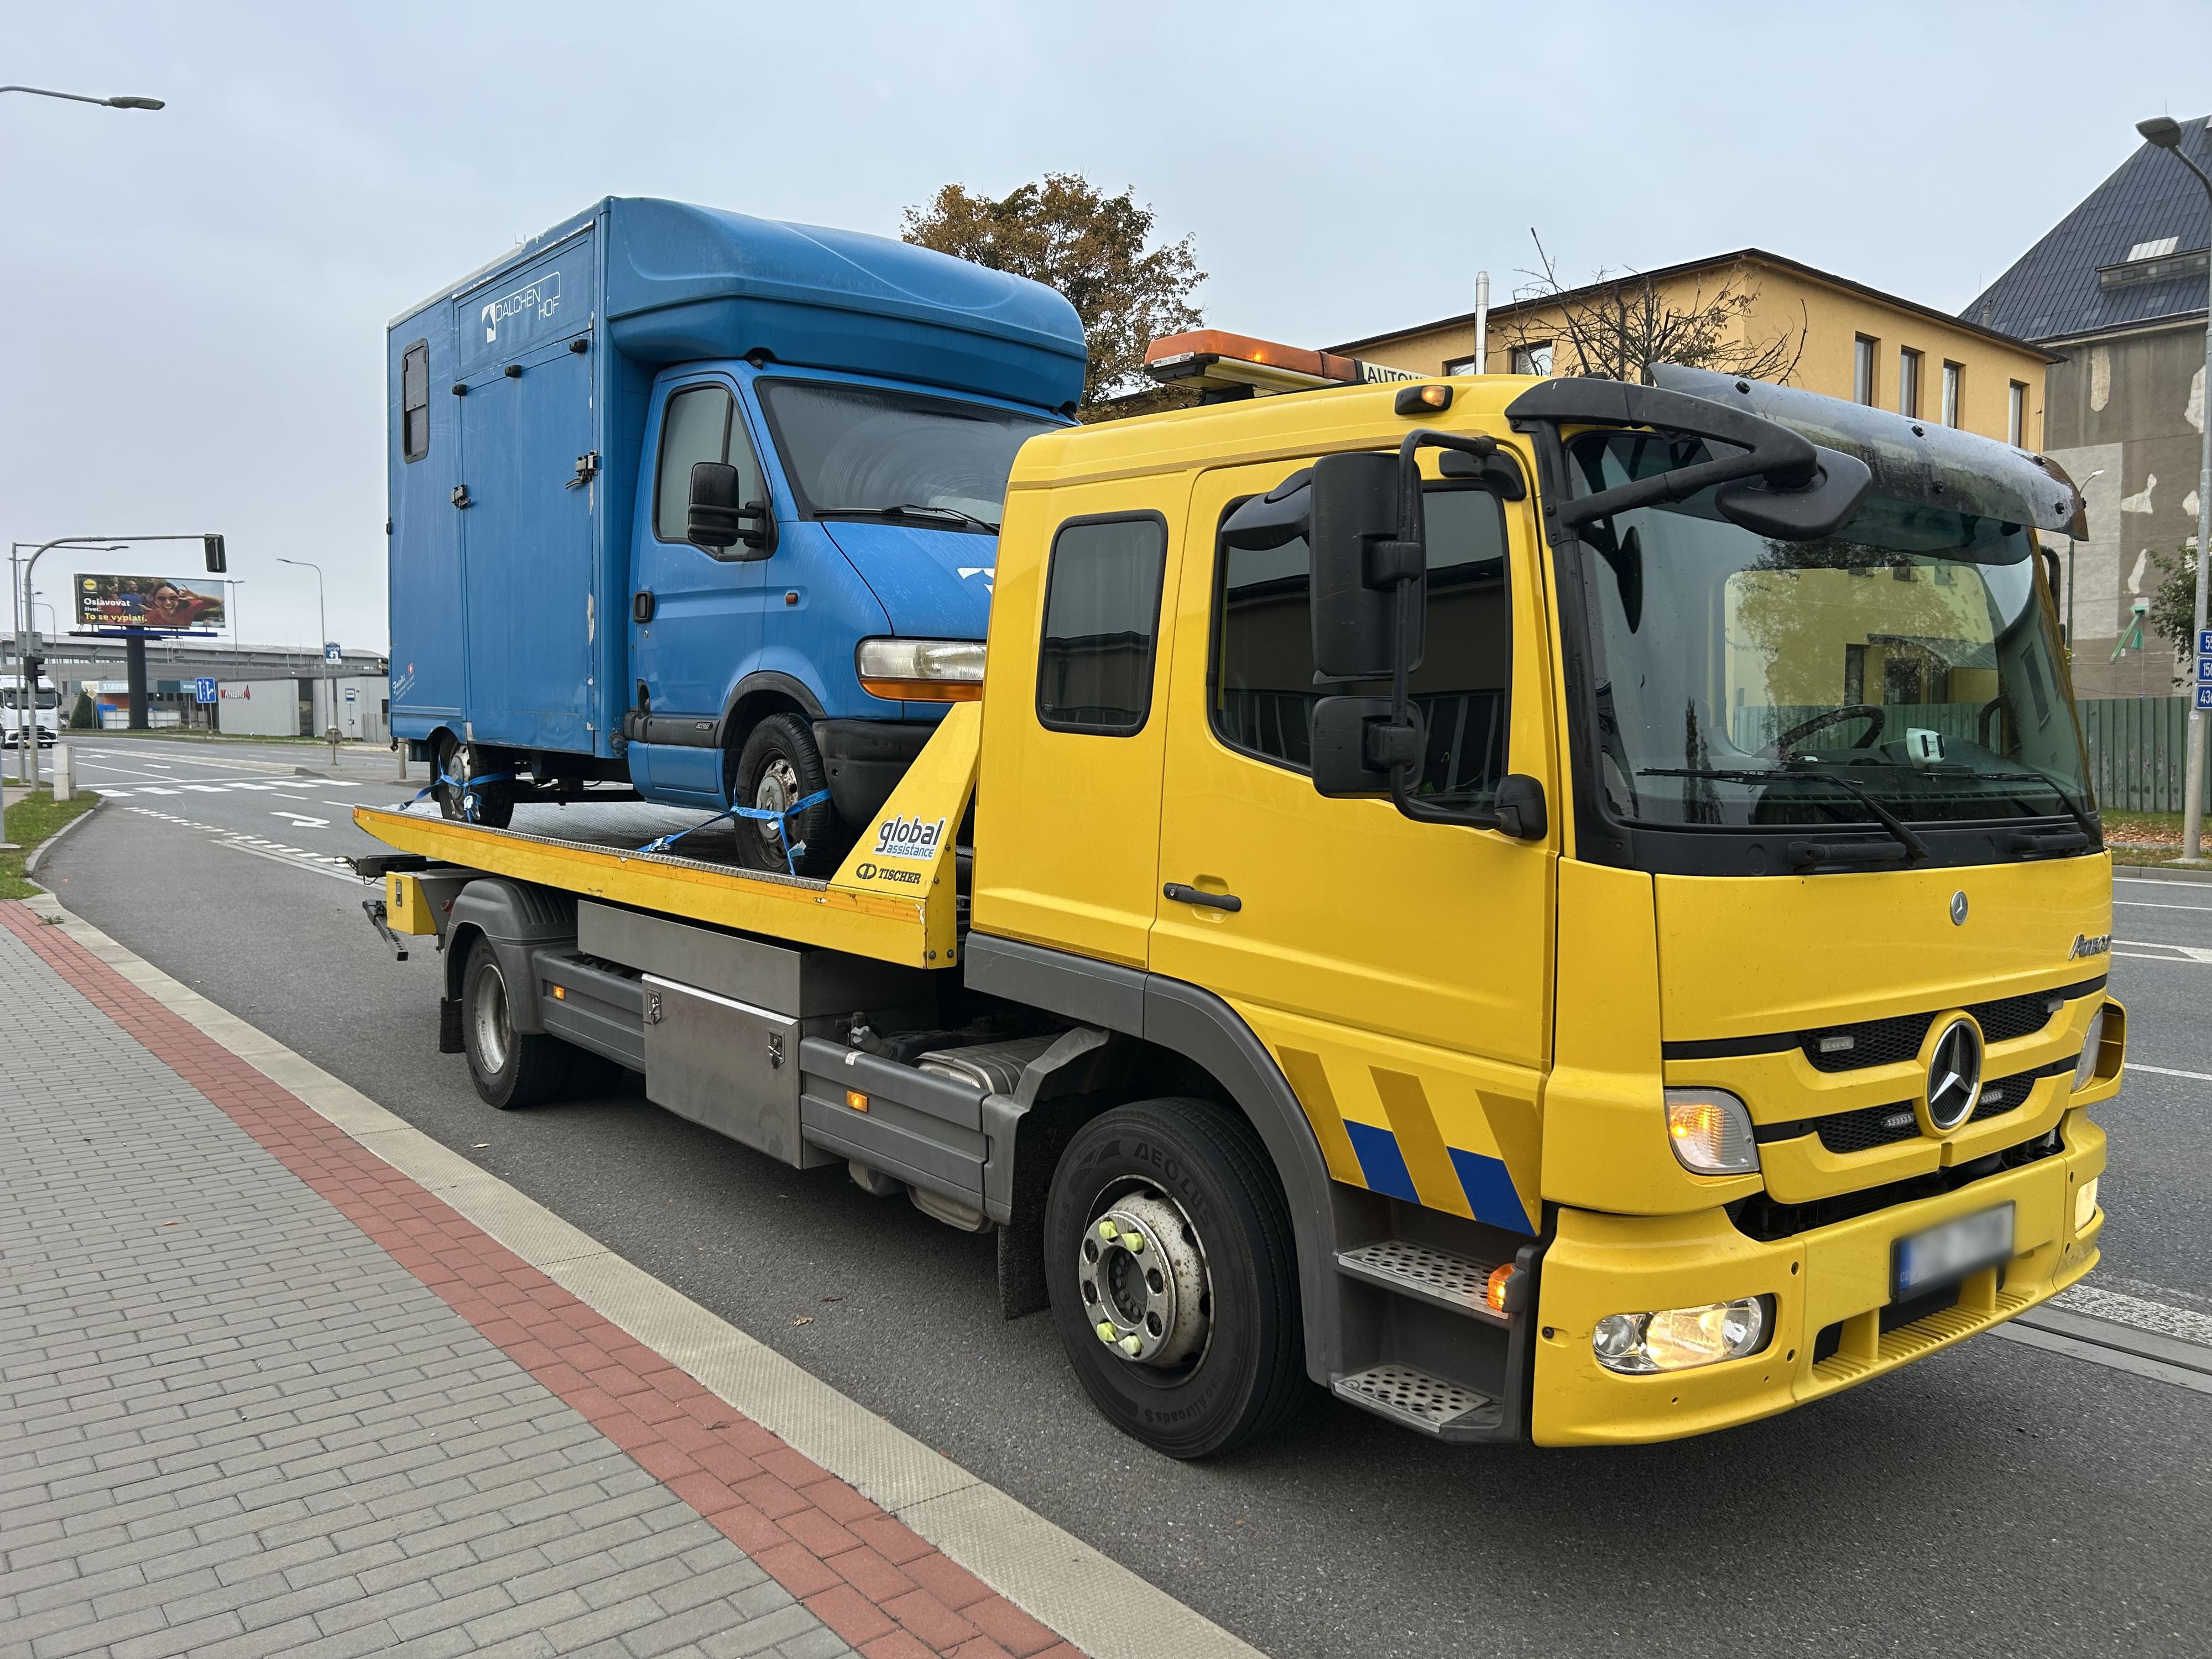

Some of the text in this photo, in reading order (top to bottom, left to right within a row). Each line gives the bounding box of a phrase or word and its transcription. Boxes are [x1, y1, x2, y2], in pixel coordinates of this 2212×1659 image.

[496, 285, 540, 322] DALCHEN
[538, 295, 560, 321] HOF
[1368, 367, 1423, 383] AUTO
[84, 597, 131, 607] Oslavovat
[875, 817, 944, 852] global
[887, 843, 935, 857] assistance
[879, 868, 921, 884] TISCHER
[1134, 1141, 1211, 1229] AEOLUS
